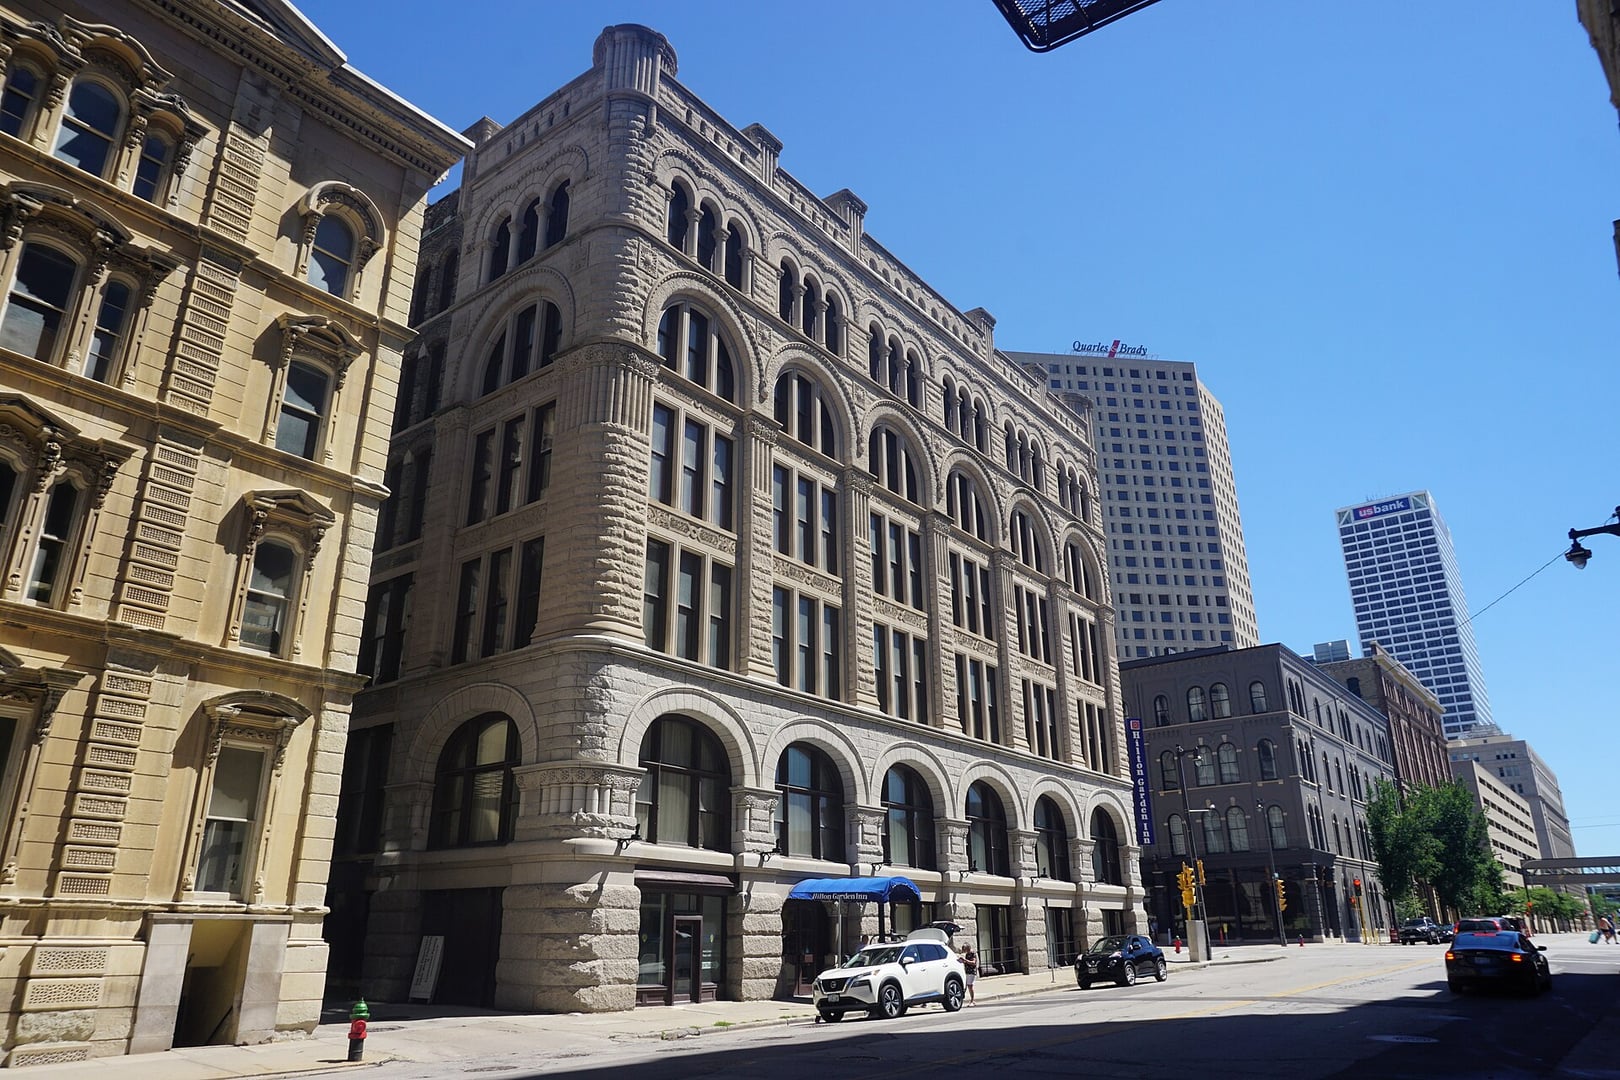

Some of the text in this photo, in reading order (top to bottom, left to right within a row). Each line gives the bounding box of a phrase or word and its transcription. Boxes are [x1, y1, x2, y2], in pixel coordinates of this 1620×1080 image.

[1073, 340, 1109, 353] Quarles
[1119, 343, 1147, 356] Brady
[1132, 731, 1151, 844] Hilton Garden Inn
